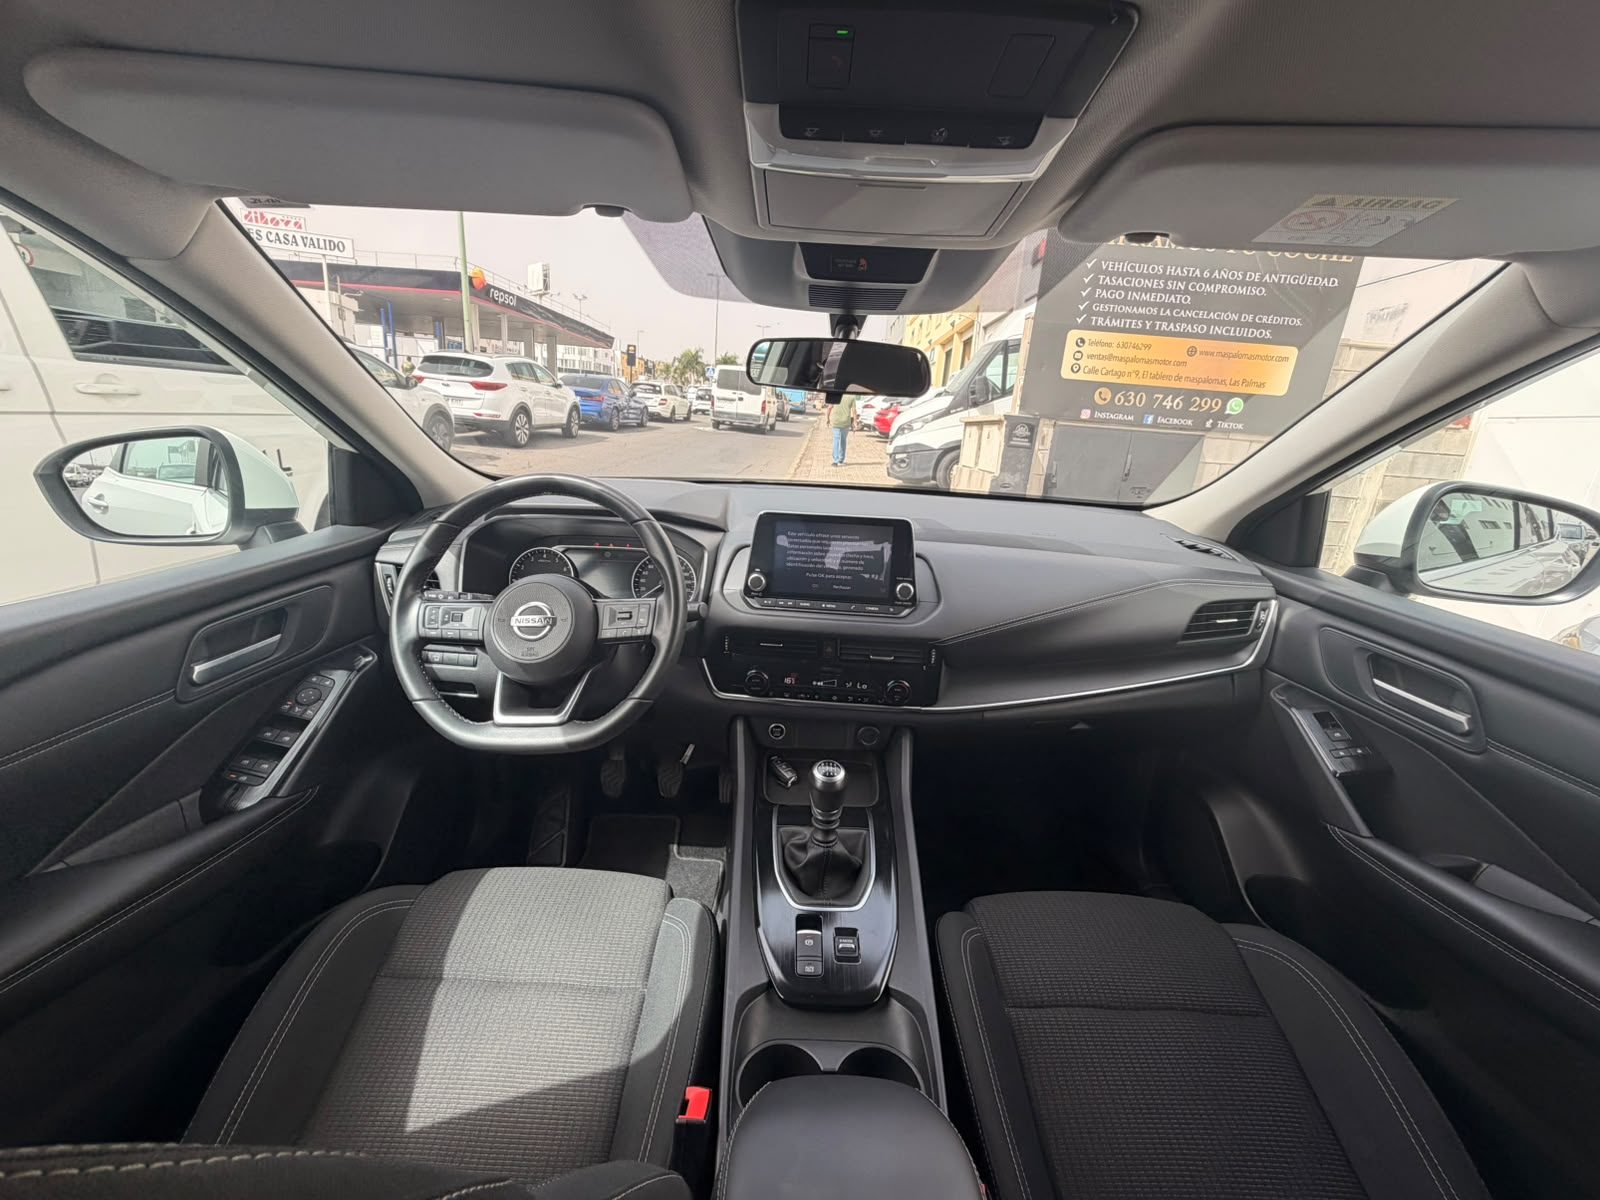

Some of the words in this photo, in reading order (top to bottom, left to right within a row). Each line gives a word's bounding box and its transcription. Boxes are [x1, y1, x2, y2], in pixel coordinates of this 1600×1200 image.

[266, 231, 299, 247] CASA
[300, 235, 346, 253] VALIDO
[1101, 260, 1164, 275] VEHÍCULOS
[1166, 266, 1201, 277] HASTA
[1203, 268, 1210, 278] 6
[1211, 268, 1244, 281] AÑOS
[1246, 271, 1261, 282] DE
[1262, 272, 1339, 287] ANTIGÜEDAD.
[1095, 288, 1125, 300] PAGO
[1127, 291, 1191, 304] INMEDIATO.
[1098, 275, 1165, 289] TASACIONES
[1166, 280, 1186, 291] SIN
[1188, 282, 1267, 297] COMPROMISO.
[490, 288, 517, 307] repsol
[1092, 303, 1158, 316] GESTIONAMOS
[1160, 308, 1171, 317] LA
[1172, 308, 1239, 321] CANCELACIÓN
[1241, 313, 1254, 322] DE
[1255, 314, 1303, 327] CRÉDITOS.
[1091, 316, 1143, 329] TRÁMITES
[1145, 320, 1152, 330] Y
[1154, 321, 1207, 334] TRASPASO
[1209, 325, 1273, 339] INCLUIDOS.
[1086, 353, 1187, 367] ventas@maspalomasmotor.com
[1199, 350, 1289, 363] www.maspalomasmotor.com
[1083, 365, 1099, 376] Calle
[1100, 367, 1126, 379] Cartago
[1142, 370, 1149, 379] El
[1149, 371, 1173, 381] tablero
[1174, 372, 1184, 381] de
[1229, 378, 1240, 387] Las
[1241, 378, 1267, 389] Palmas
[1114, 390, 1147, 408] 630
[1153, 394, 1185, 410] 746
[1188, 396, 1223, 413] 299
[1094, 411, 1134, 421] INSTAGRAM
[1157, 416, 1193, 426] FACEBOOK
[514, 617, 553, 625] NISSAN
